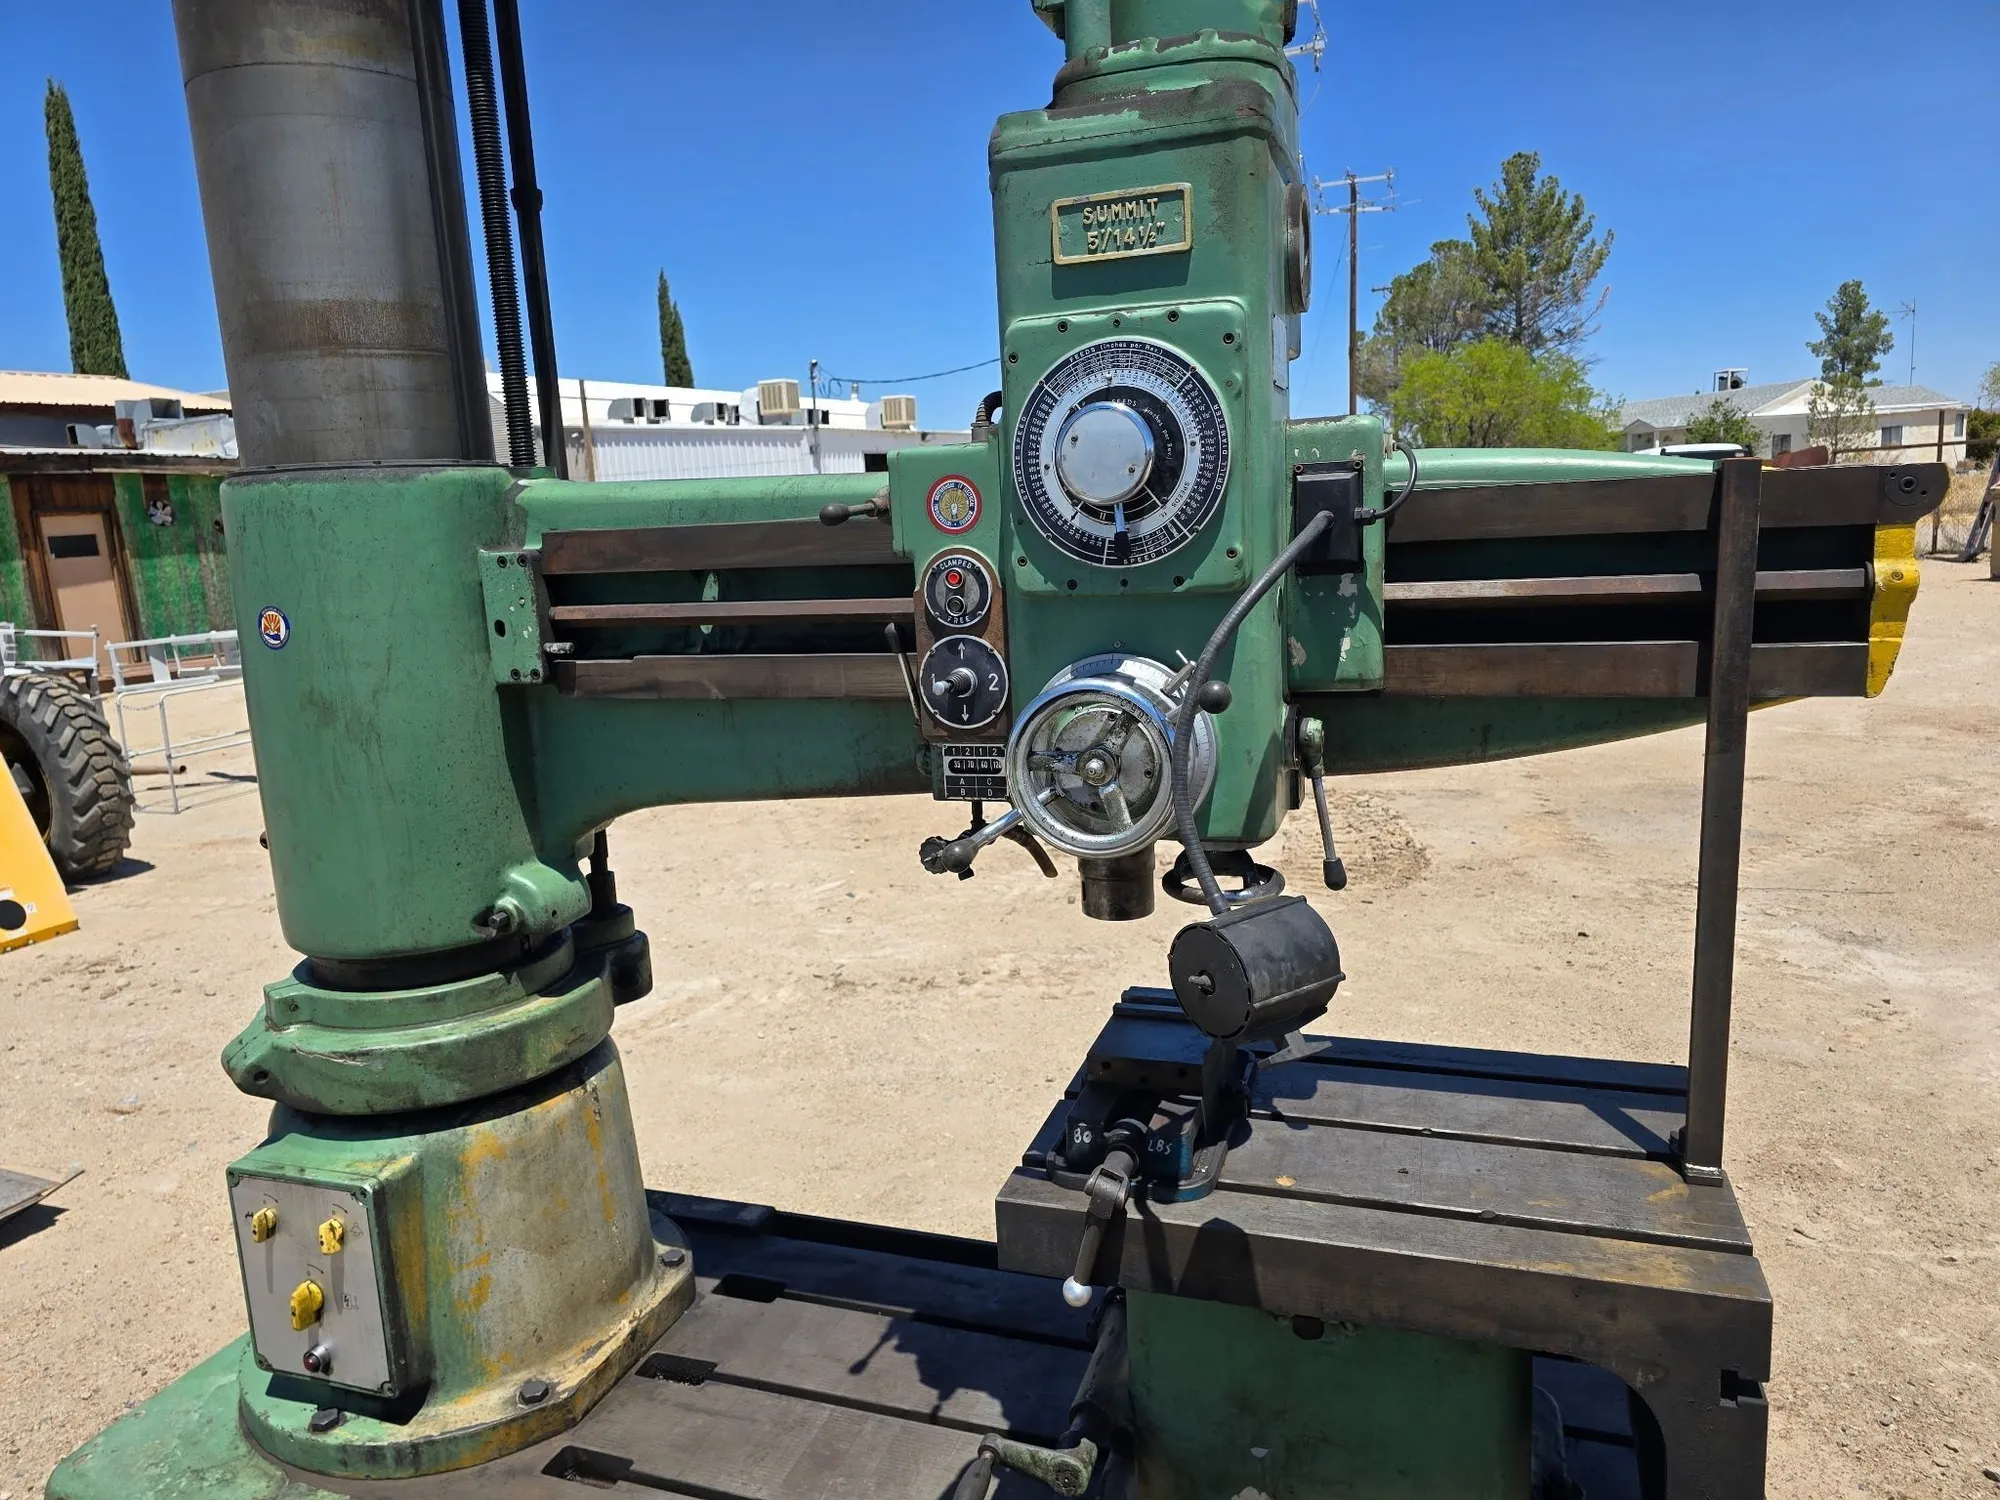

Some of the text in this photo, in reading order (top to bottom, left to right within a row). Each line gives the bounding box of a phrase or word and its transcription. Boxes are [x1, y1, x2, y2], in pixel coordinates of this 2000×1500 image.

[1082, 198, 1158, 224] SUMMIT
[1069, 347, 1096, 362] FEEDS
[1214, 403, 1228, 490] DRILL DIAMETER
[1015, 416, 1028, 501] SPINDLE SPEED
[939, 558, 973, 571] CLAMPED
[1123, 552, 1156, 565] SPEED
[946, 615, 971, 625] FREE
[988, 673, 999, 691] 2
[952, 747, 998, 755] 1 2 1 2
[986, 777, 992, 785] C
[987, 788, 993, 796] D
[1073, 1127, 1173, 1155] 80 LBS
